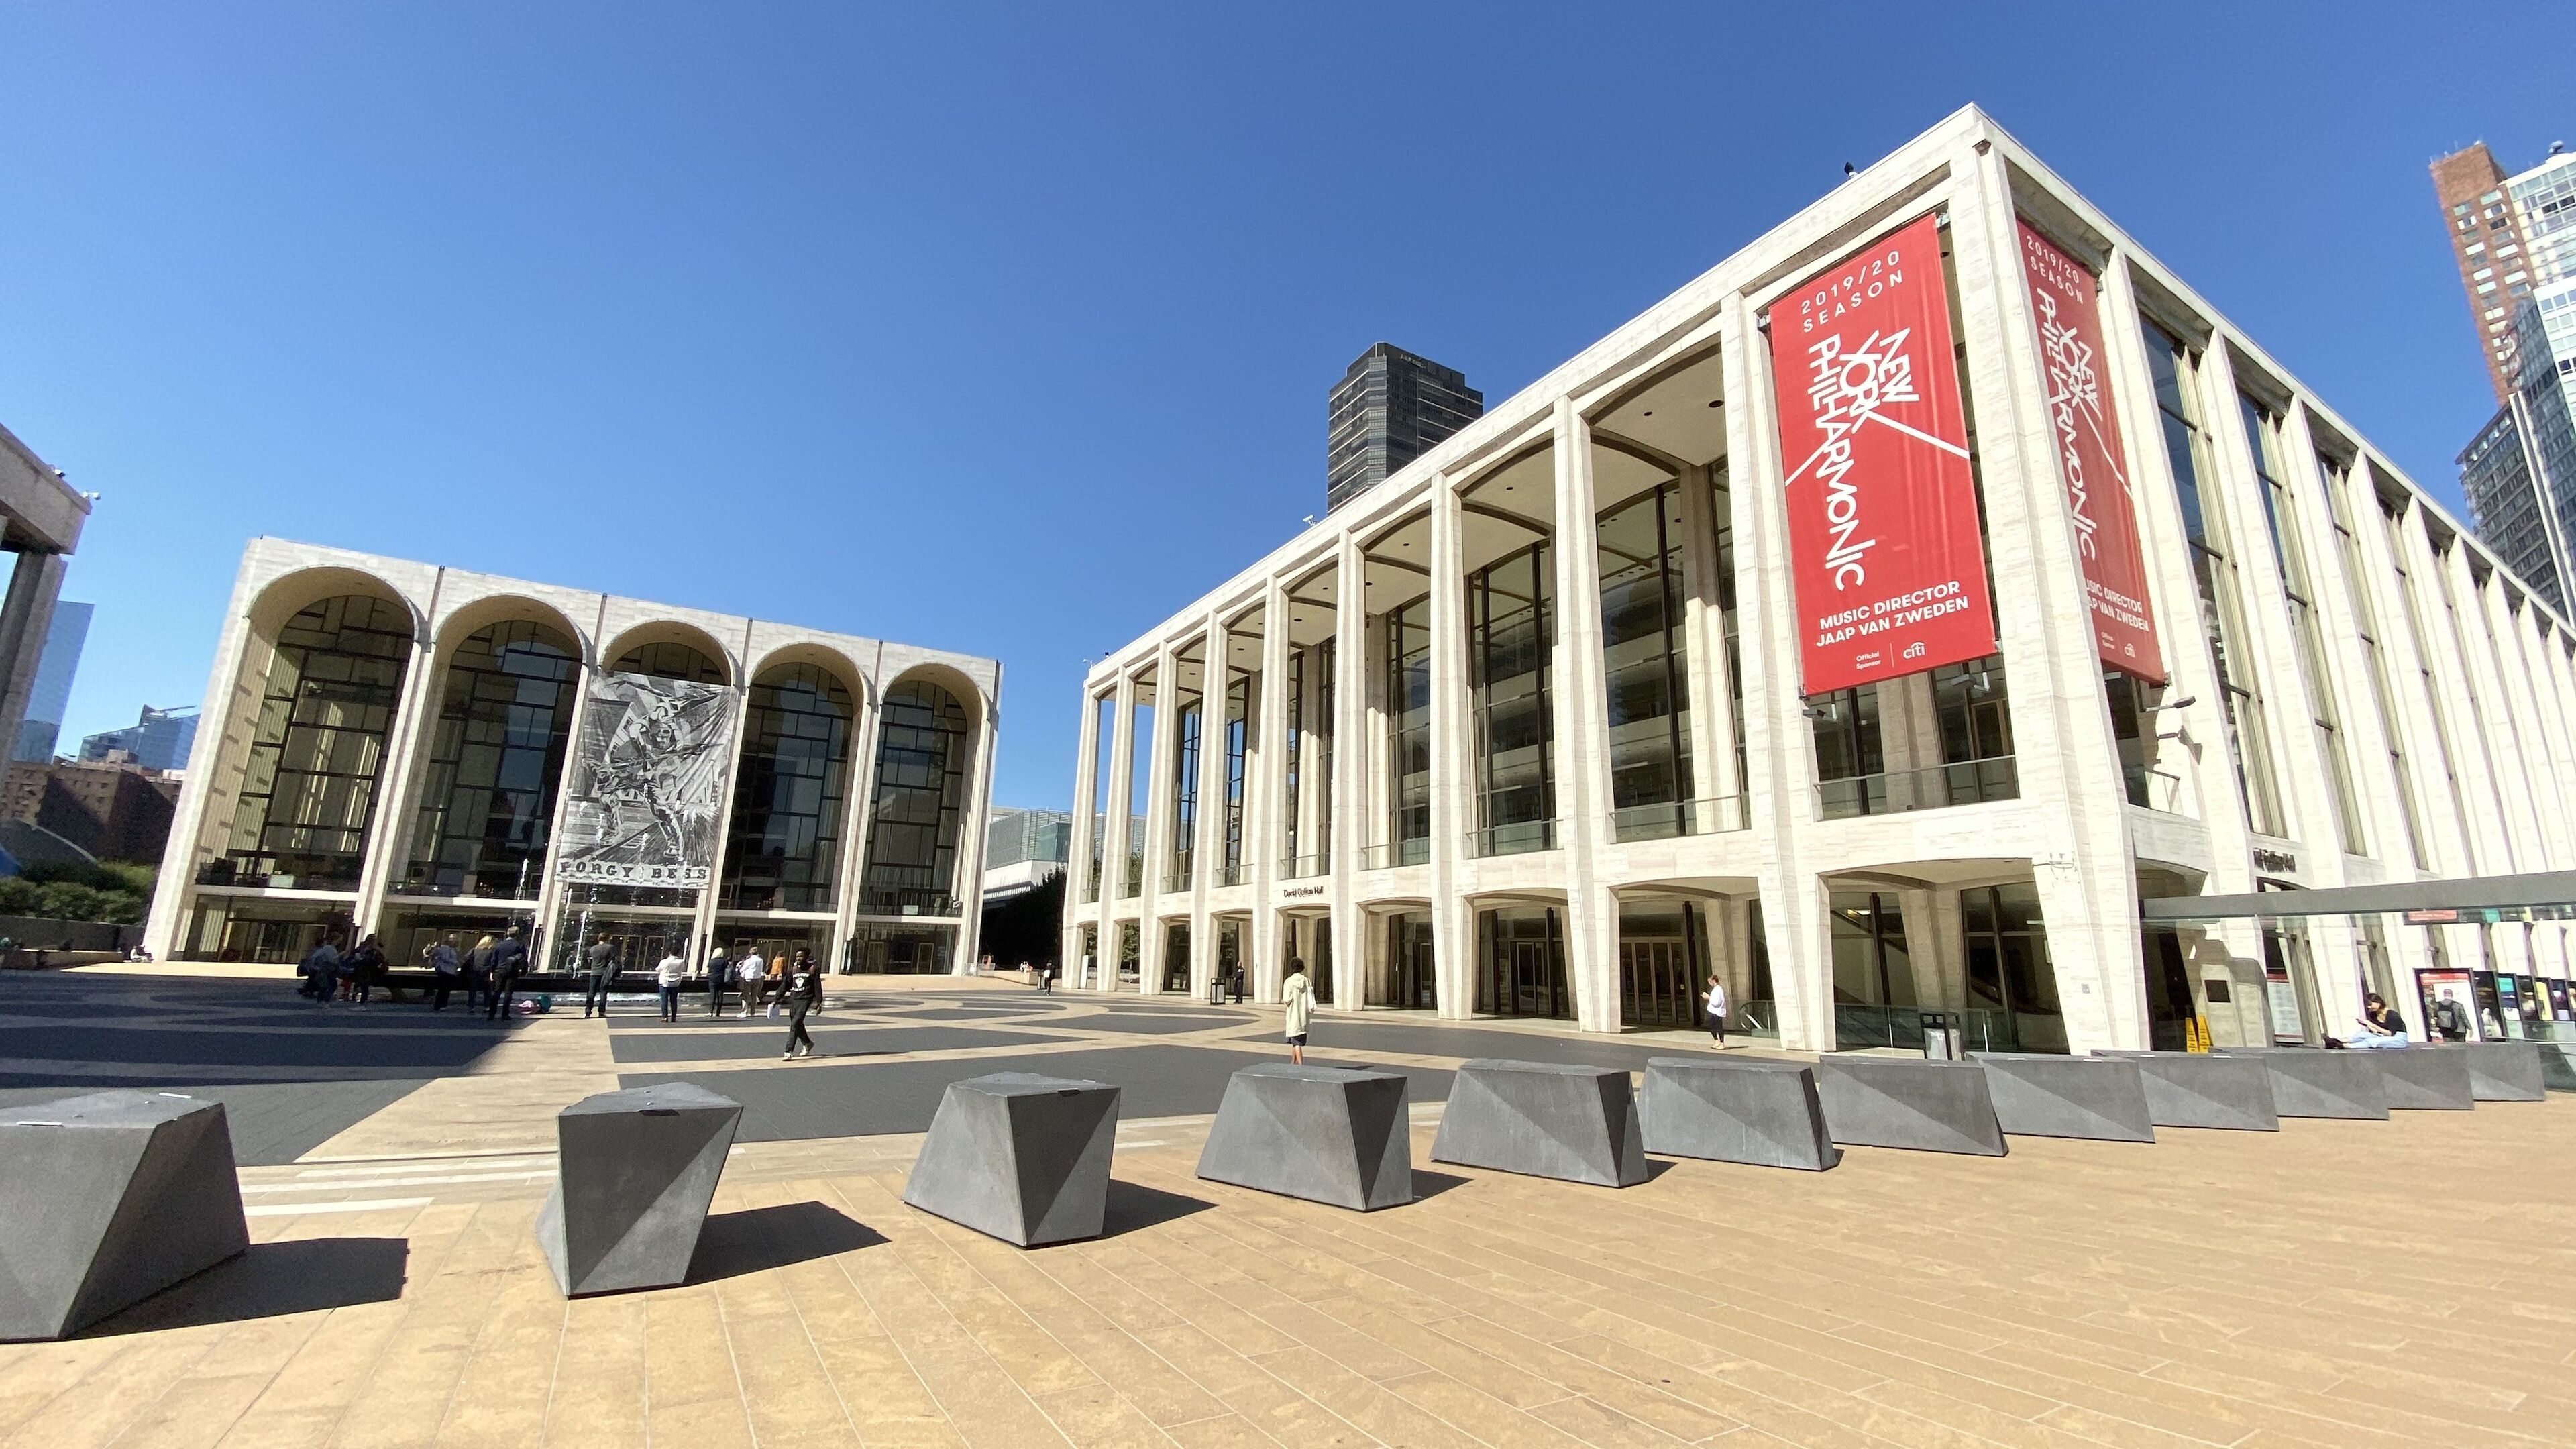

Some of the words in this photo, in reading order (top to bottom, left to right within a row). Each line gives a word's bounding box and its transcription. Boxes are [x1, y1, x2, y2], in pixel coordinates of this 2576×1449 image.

[1801, 250, 1900, 315] 2019/20
[2027, 235, 2080, 284] 2019/20
[2030, 256, 2083, 304] SEASON
[1803, 270, 1903, 333] SEASON
[1878, 327, 1920, 402] NEW
[1784, 333, 1876, 592] PHILHARMONIC
[1819, 606, 1870, 630] MUSIC
[1874, 580, 1960, 614] DIRECTOR
[2086, 578, 2103, 596] USIC
[2103, 587, 2143, 613] DIRECTOR
[2098, 600, 2114, 617] VAN
[2115, 608, 2149, 631] ZWEDEN
[1816, 627, 1856, 647] JAAP
[1859, 616, 1890, 636] VAN
[1894, 596, 1969, 628] ZWEDEN
[1856, 651, 1880, 661] Official
[1903, 642, 1926, 659] citi
[559, 861, 634, 879] PORGY
[651, 867, 706, 880] BESS
[1283, 888, 1297, 898] David
